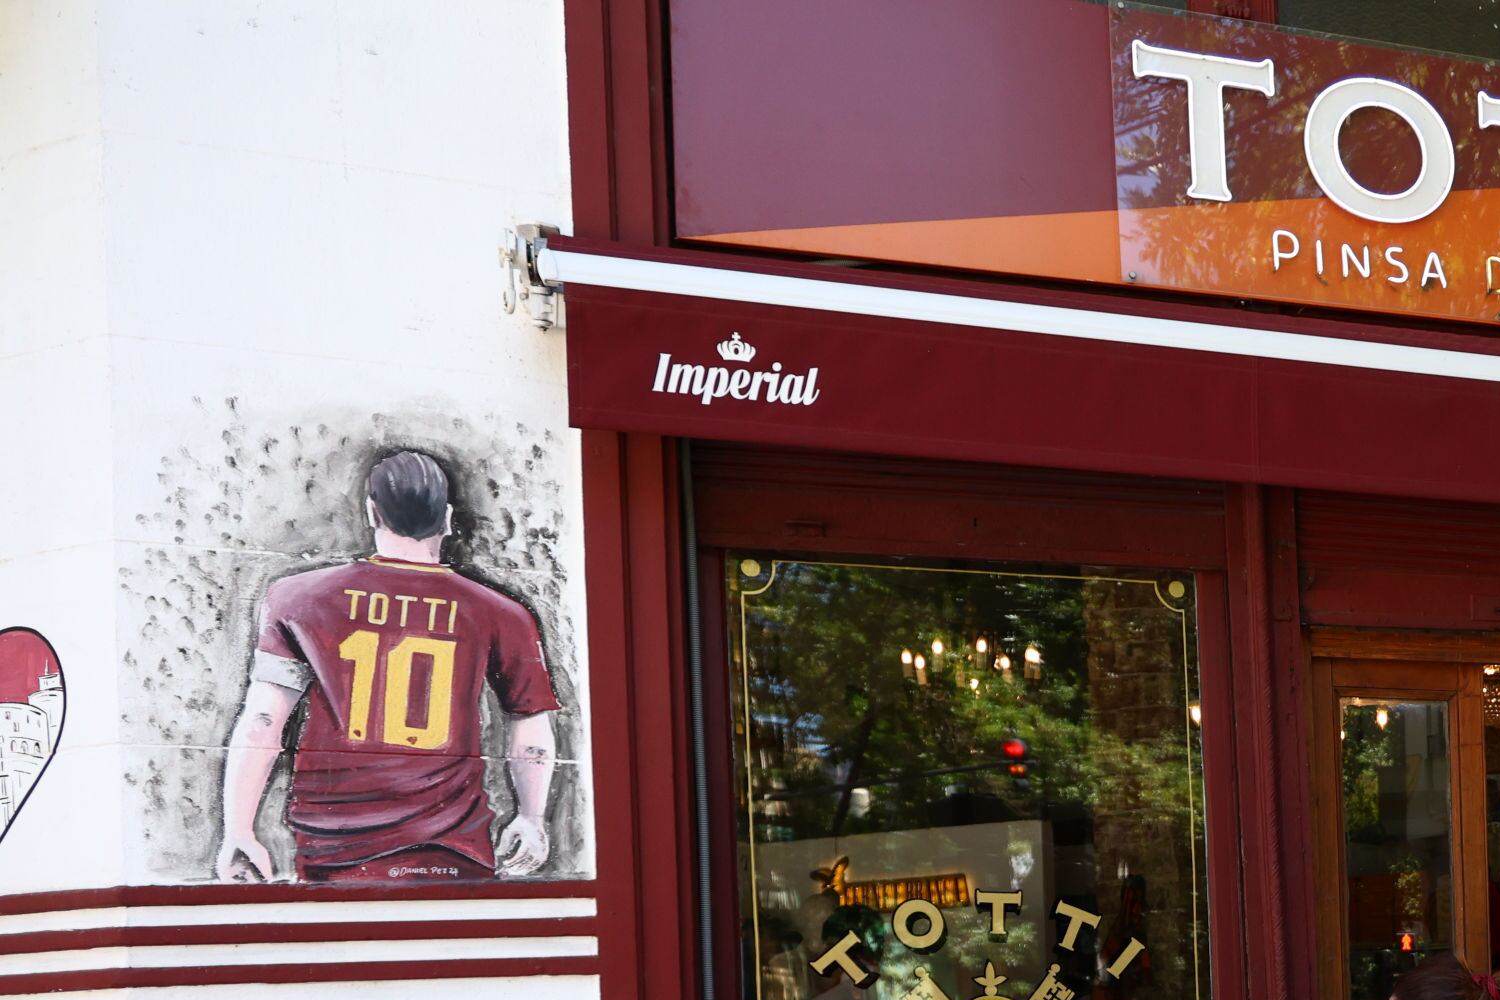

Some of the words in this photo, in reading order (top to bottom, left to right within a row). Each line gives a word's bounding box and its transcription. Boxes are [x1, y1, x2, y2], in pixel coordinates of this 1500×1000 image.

[1272, 229, 1449, 290] PINSA
[652, 352, 821, 406] Imperial
[344, 589, 458, 634] TOTTI
[338, 629, 457, 750] 10
[810, 889, 1145, 986] TOTTI
